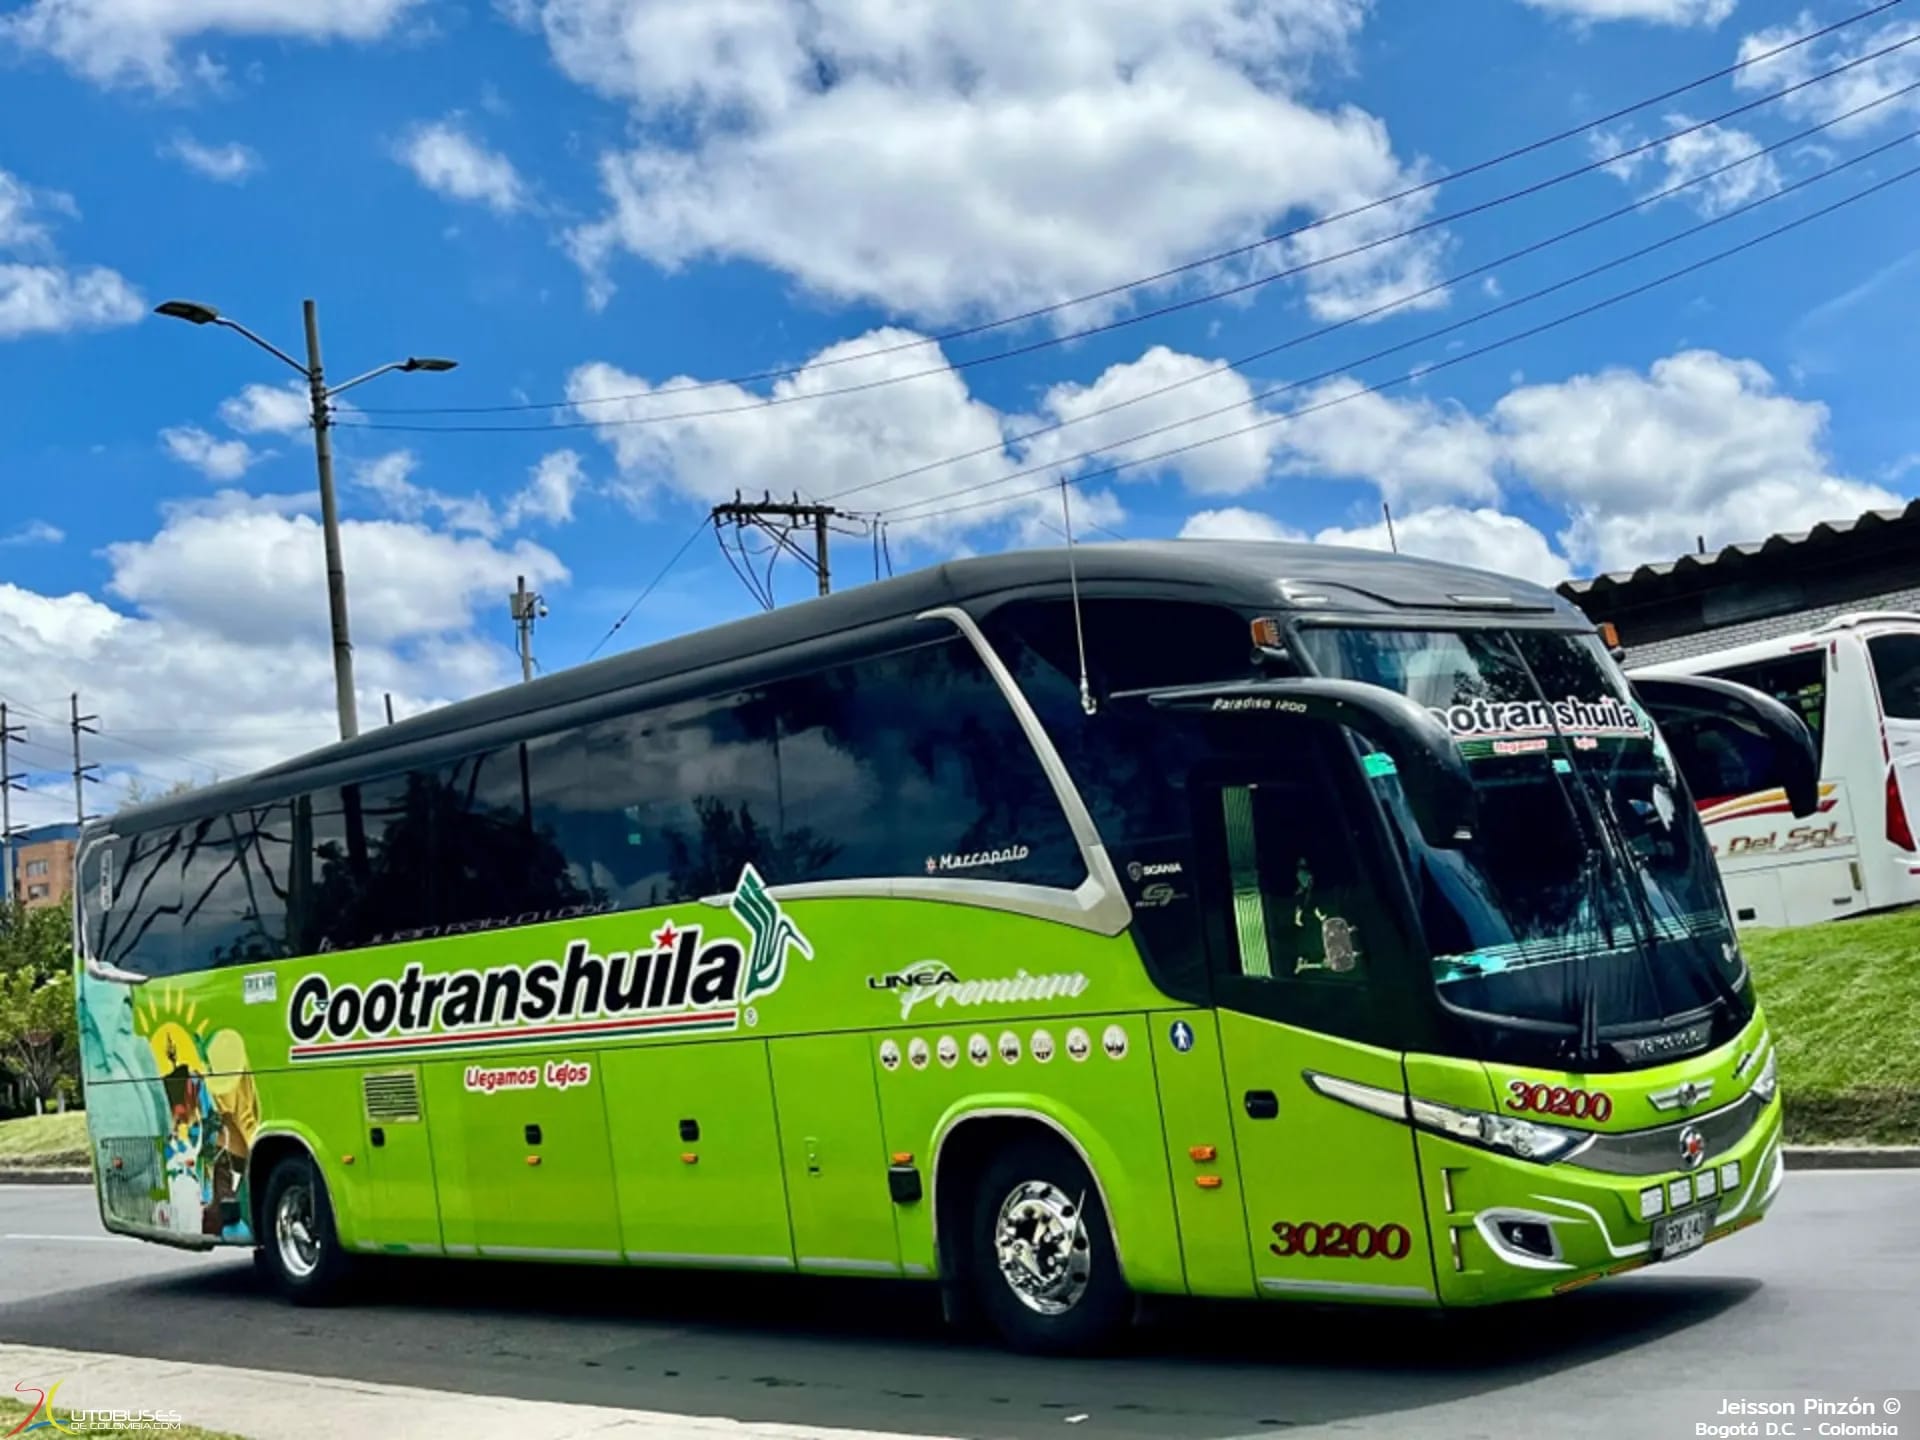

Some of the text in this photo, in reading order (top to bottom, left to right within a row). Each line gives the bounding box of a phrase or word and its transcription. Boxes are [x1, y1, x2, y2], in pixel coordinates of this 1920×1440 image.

[1212, 696, 1308, 713] Paradiso 1200
[1428, 695, 1640, 734] ootranshuila
[939, 845, 1029, 870] Marcopolo
[1143, 862, 1182, 876] SCANIA
[289, 921, 743, 1041] Cootranshuila
[868, 960, 1089, 1020] LINEA Premium
[546, 1063, 588, 1088] Lejos
[1505, 1080, 1613, 1123] 30200
[1269, 1220, 1411, 1261] 30200
